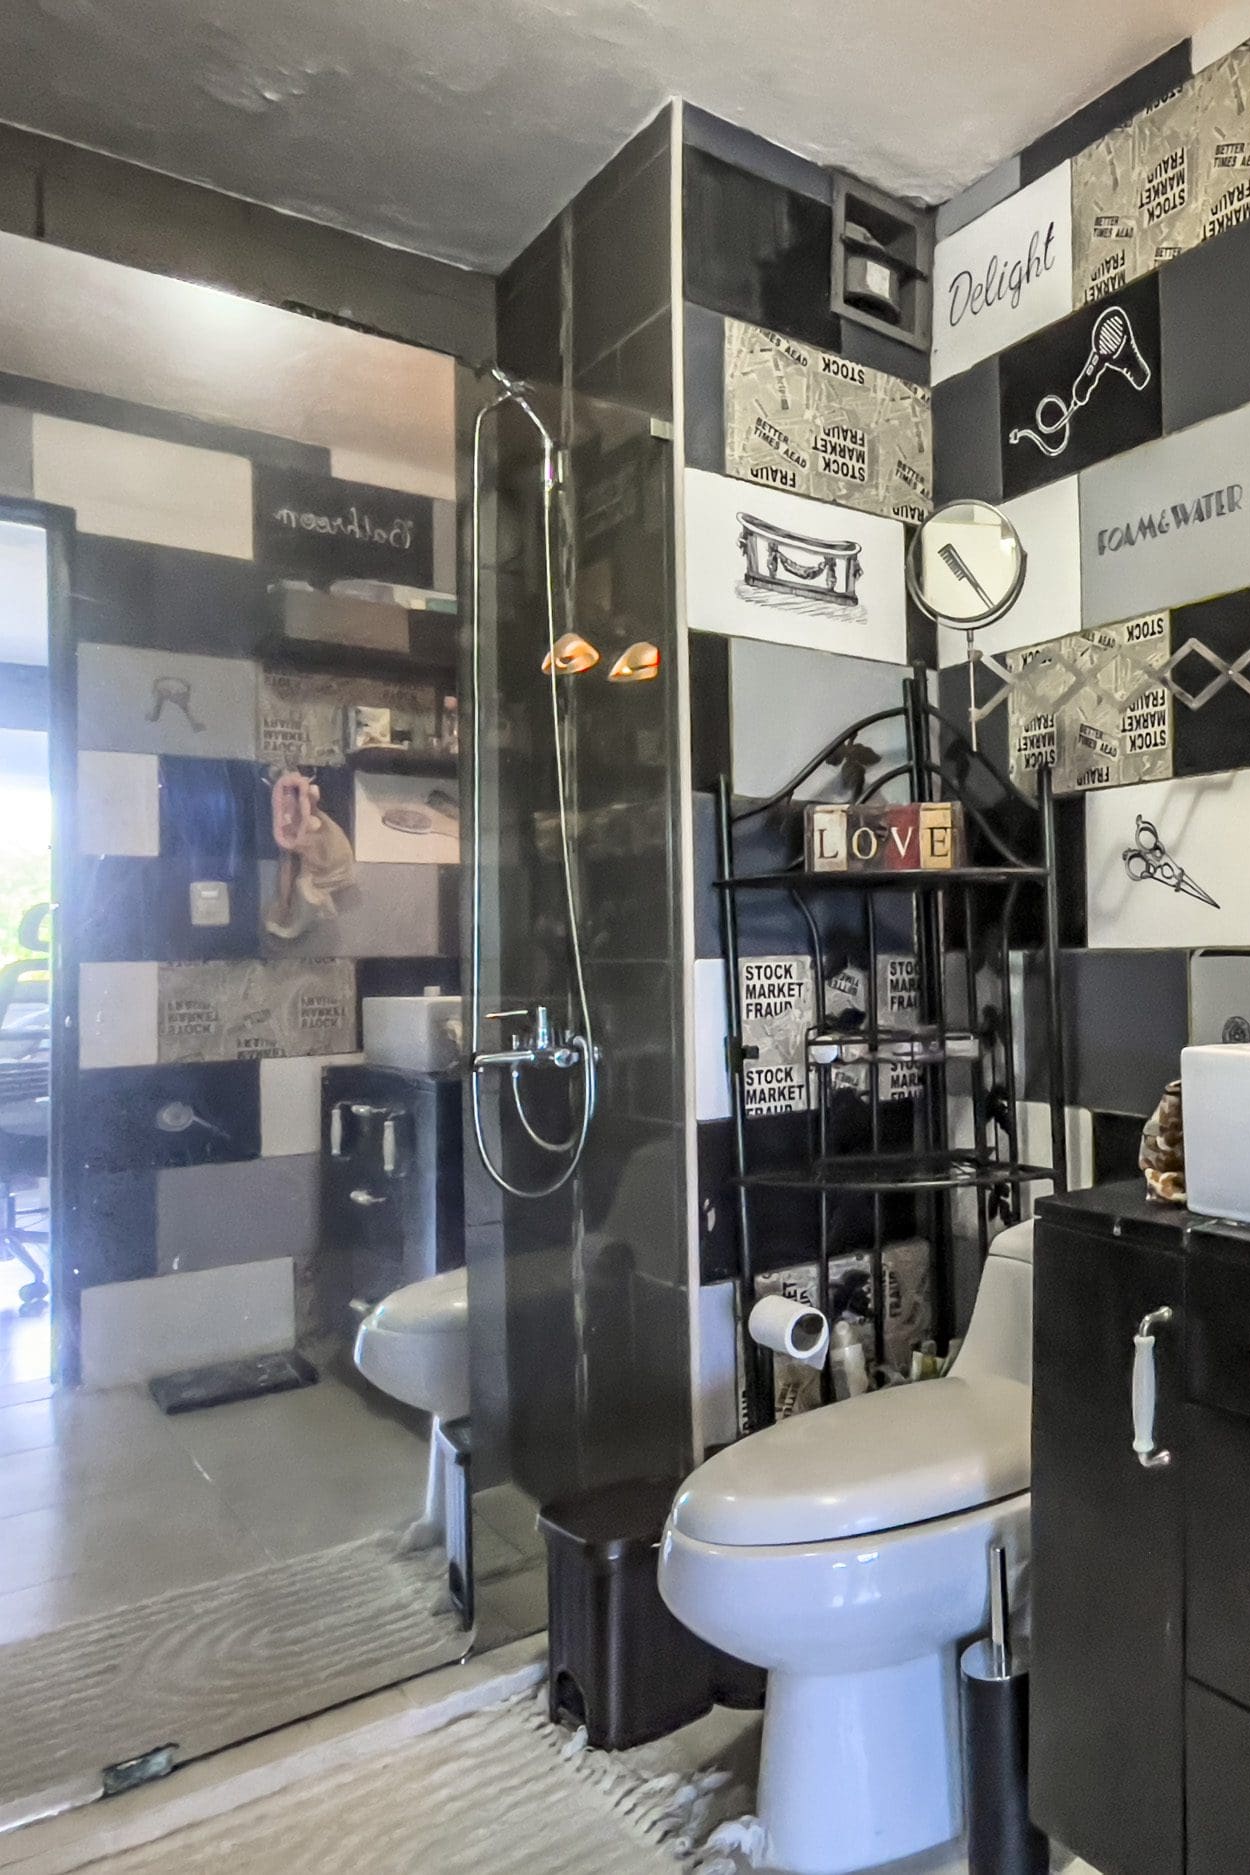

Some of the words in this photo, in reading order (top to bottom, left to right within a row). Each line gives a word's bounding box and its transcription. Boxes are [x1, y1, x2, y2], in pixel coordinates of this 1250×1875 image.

[1215, 142, 1245, 155] BETTER
[1214, 155, 1236, 168] TIMES
[1138, 167, 1186, 209] MARKET
[1148, 187, 1186, 225] STOCK
[948, 221, 1055, 327] Delight
[822, 356, 865, 385] STOCK
[755, 416, 790, 445] BETTER
[753, 426, 780, 450] TIMES
[783, 446, 808, 469] AEAD
[812, 435, 865, 464] MARKET
[751, 466, 797, 488] FRAUD
[823, 456, 866, 482] STOCK
[892, 505, 925, 523] RAUD
[1126, 617, 1164, 642] STOCK
[1120, 709, 1166, 733] MARKET
[1017, 731, 1055, 752] MARKET
[1128, 730, 1166, 752] STOCK
[1024, 750, 1056, 769] STOCK
[818, 826, 951, 860] LOVE
[745, 963, 793, 981] STOCK
[745, 982, 804, 1000] MARKET
[746, 1001, 793, 1019] FRAUD
[745, 1067, 794, 1086] STOCK
[745, 1085, 805, 1105] MARKET
